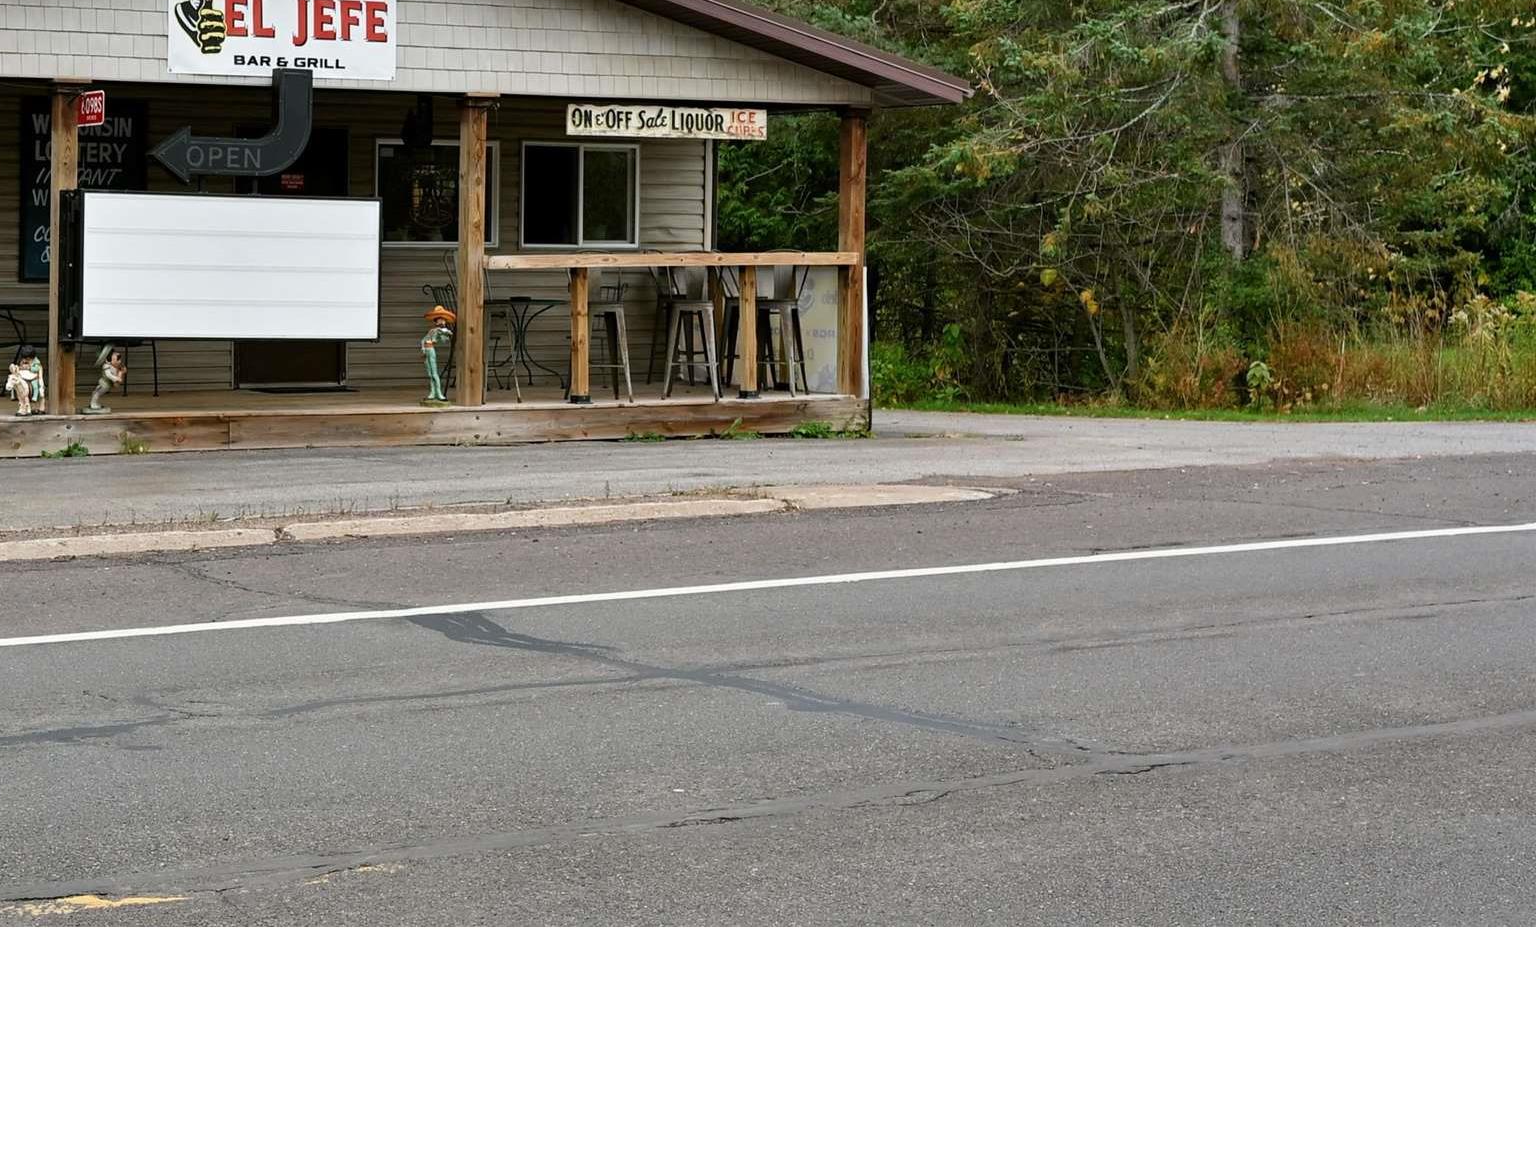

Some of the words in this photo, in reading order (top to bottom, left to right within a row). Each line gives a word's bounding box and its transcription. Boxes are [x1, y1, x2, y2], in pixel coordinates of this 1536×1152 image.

[233, 54, 271, 68] BAR
[276, 56, 289, 68] &
[294, 56, 346, 70] GRILL
[32, 113, 133, 138] WONSIN
[571, 107, 593, 129] ON
[605, 108, 633, 130] OFF
[638, 107, 668, 130] Sale
[671, 110, 724, 134] LIQUOR
[730, 111, 757, 124] ICE
[34, 140, 128, 163] LTERY
[185, 145, 262, 170] OPEN
